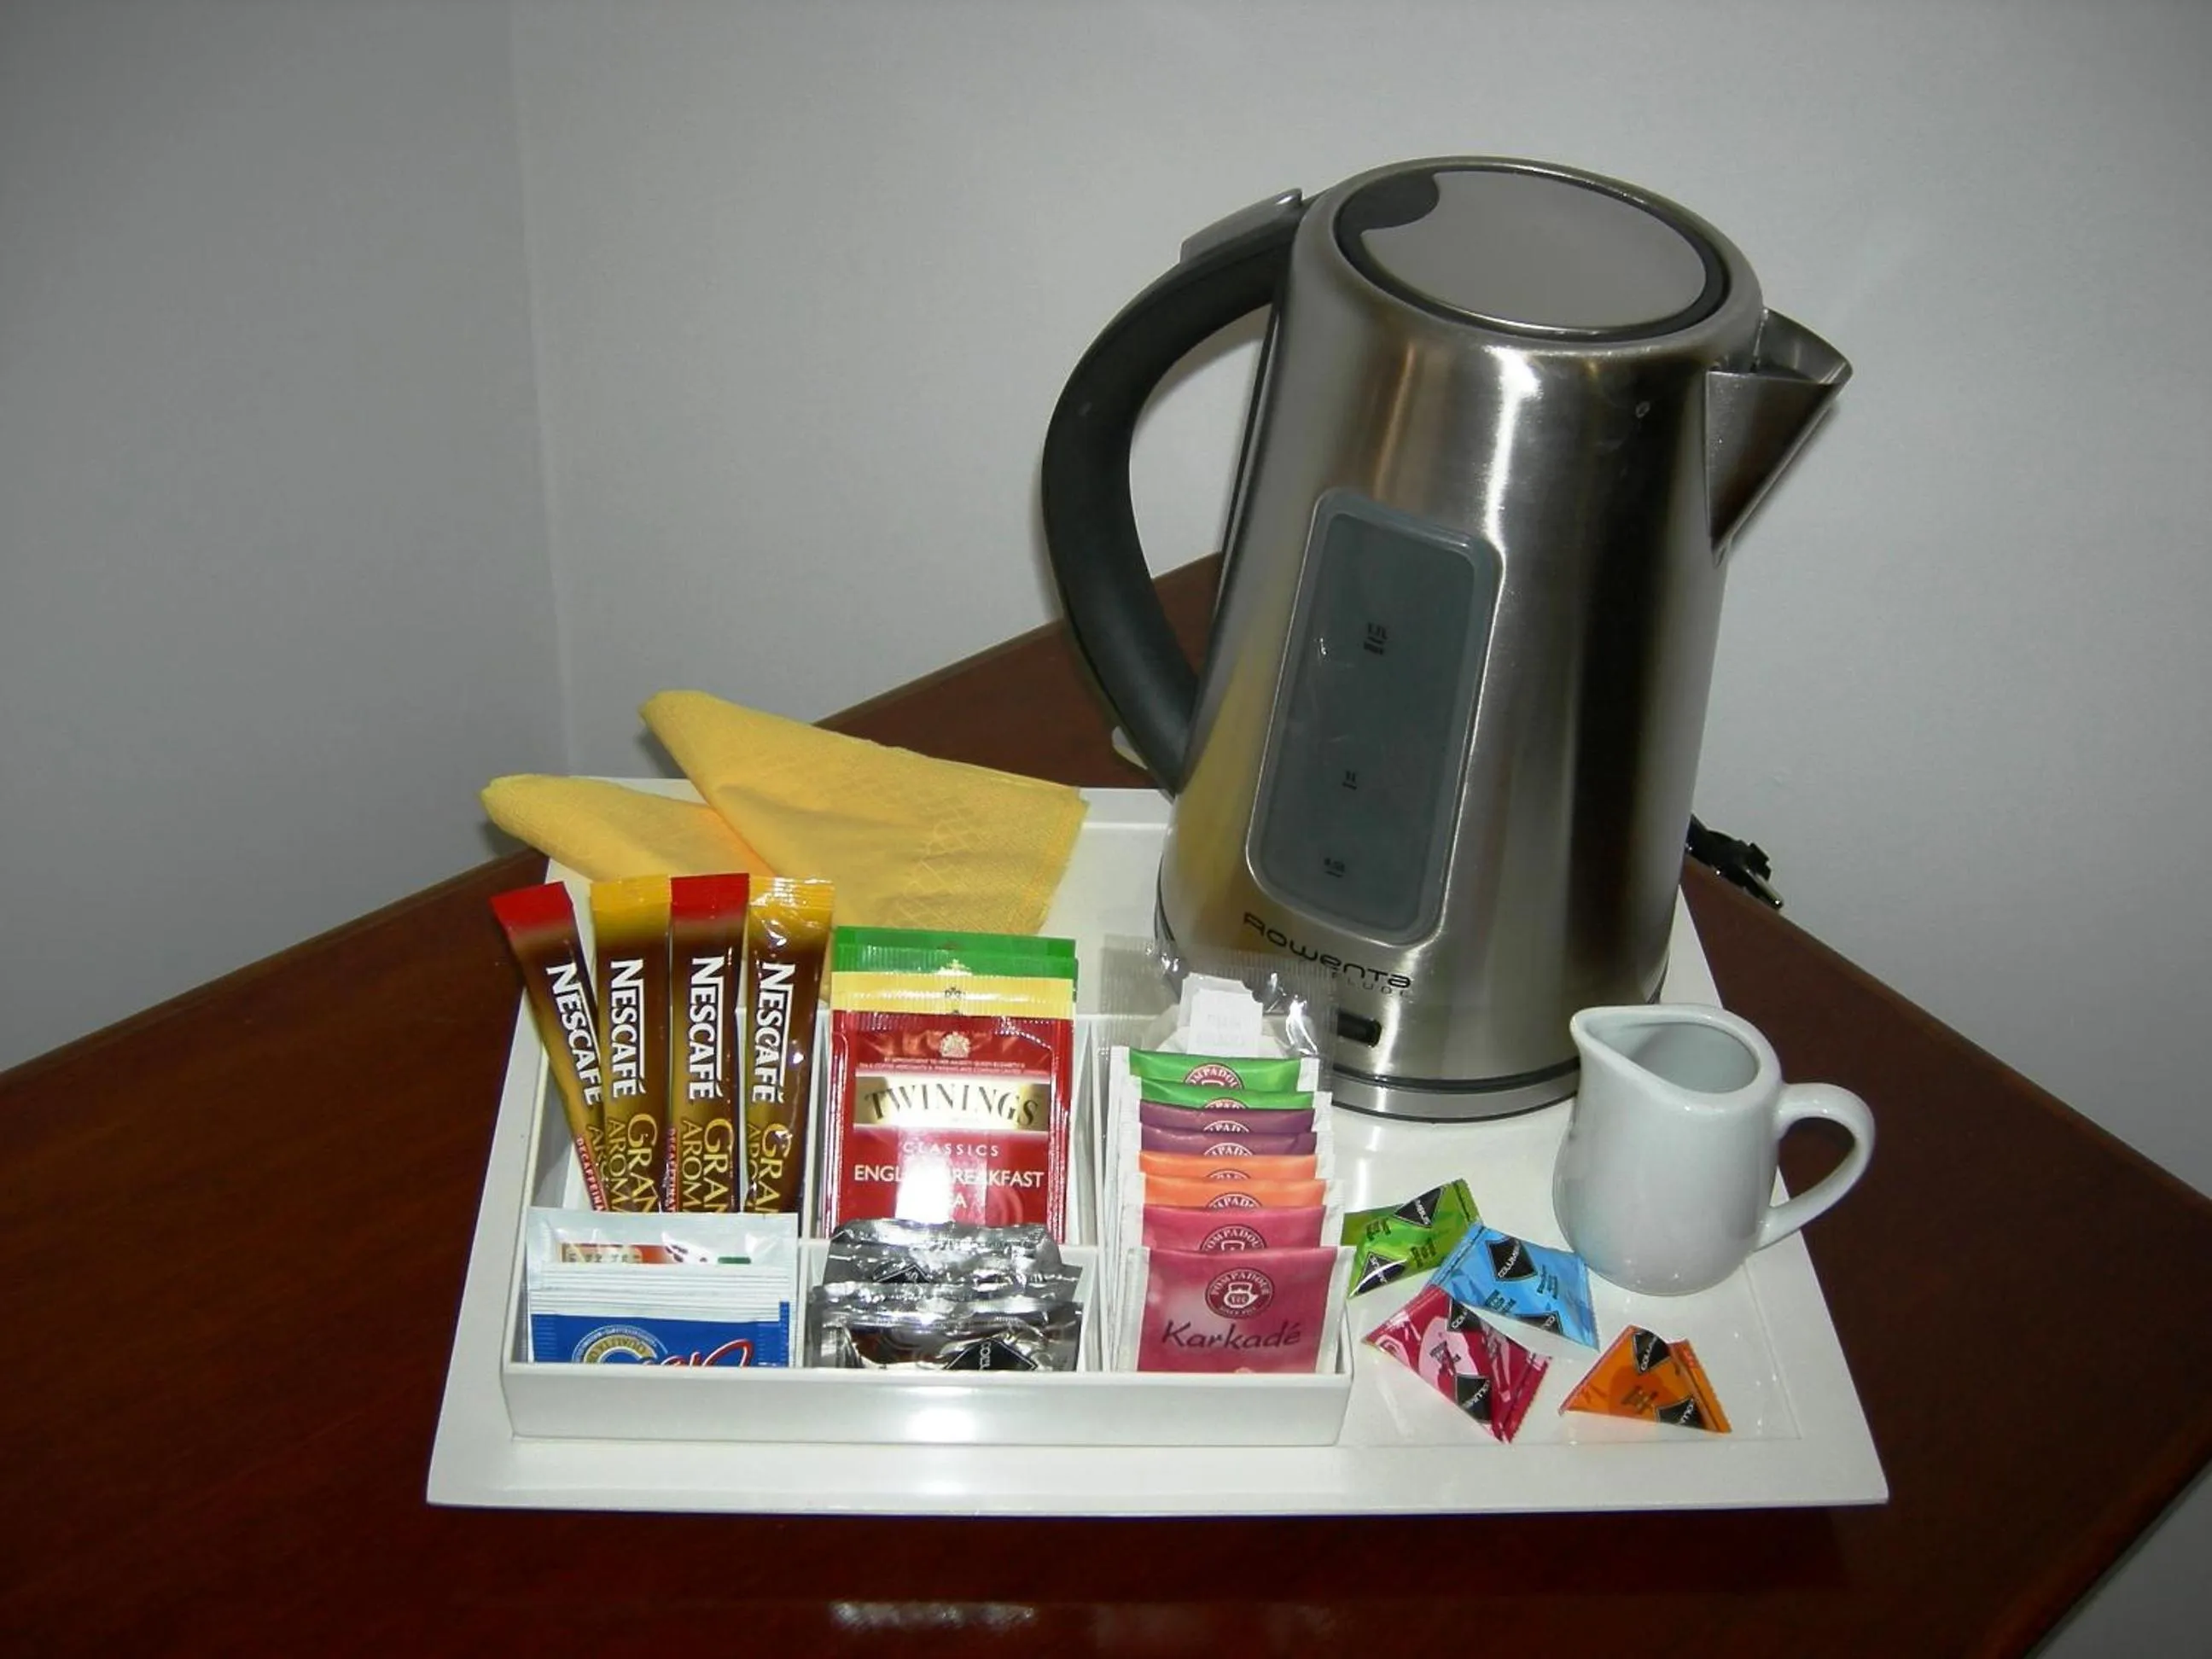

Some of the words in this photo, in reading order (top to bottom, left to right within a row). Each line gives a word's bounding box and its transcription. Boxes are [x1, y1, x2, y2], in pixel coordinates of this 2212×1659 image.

[610, 958, 647, 1099] NESCAFÉ
[689, 956, 727, 1101] NESCAFÉ
[864, 1083, 1039, 1126] TWININGS
[606, 1120, 629, 1212] AROM
[682, 1119, 703, 1212] AROM
[854, 1164, 901, 1183] ENGL
[952, 1168, 1045, 1188] REAKFAST
[903, 1143, 999, 1157] CLASSICS
[1161, 1318, 1301, 1350] Karkadé
